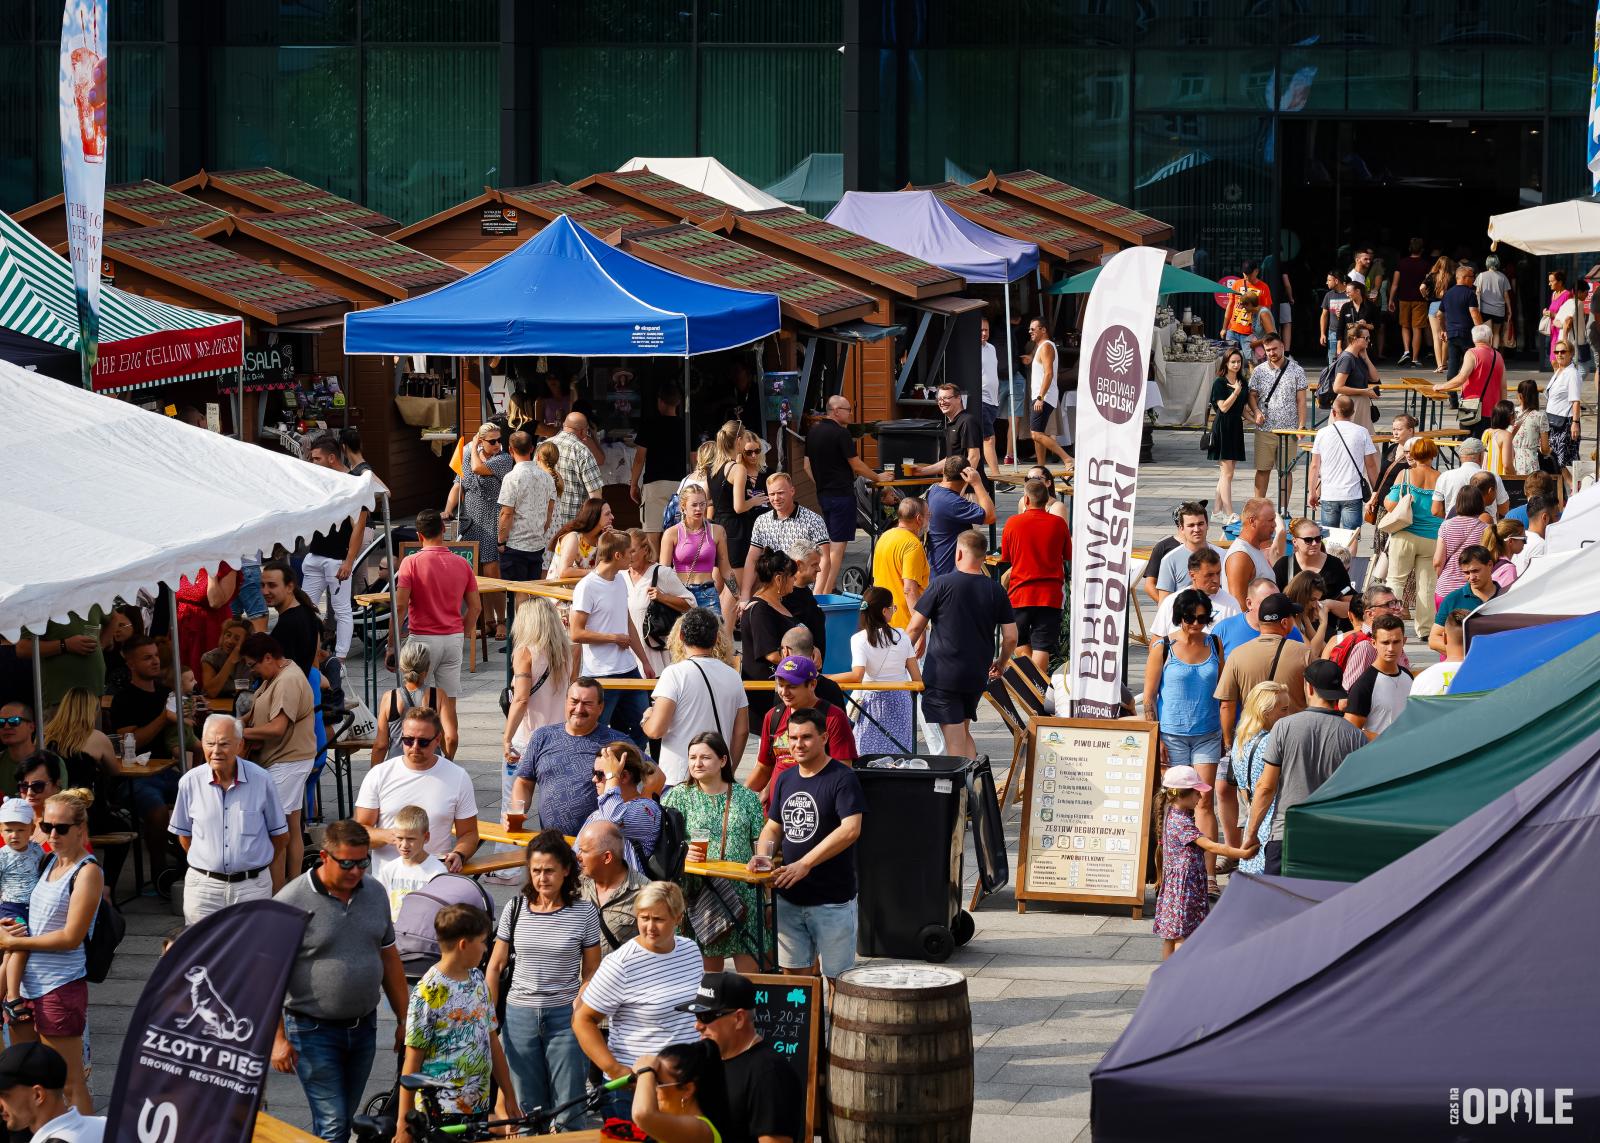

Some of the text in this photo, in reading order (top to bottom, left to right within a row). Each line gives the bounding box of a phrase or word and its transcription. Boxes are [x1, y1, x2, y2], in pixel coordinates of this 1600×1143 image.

[96, 355, 116, 376] THE
[1097, 377, 1136, 400] BROWAR
[1096, 392, 1134, 414] OPOLSKI
[1101, 462, 1137, 683] OPOLSKI
[353, 721, 374, 736] Brit
[1073, 739, 1092, 748] PIWO
[1045, 825, 1126, 836] ZESTAW DEGUSTACYJNY
[755, 990, 769, 1004] KI
[142, 1030, 264, 1077] ZŁOTY PIES
[773, 1041, 799, 1054] GIN
[139, 1055, 258, 1096] BROWAR RESTAURACJA
